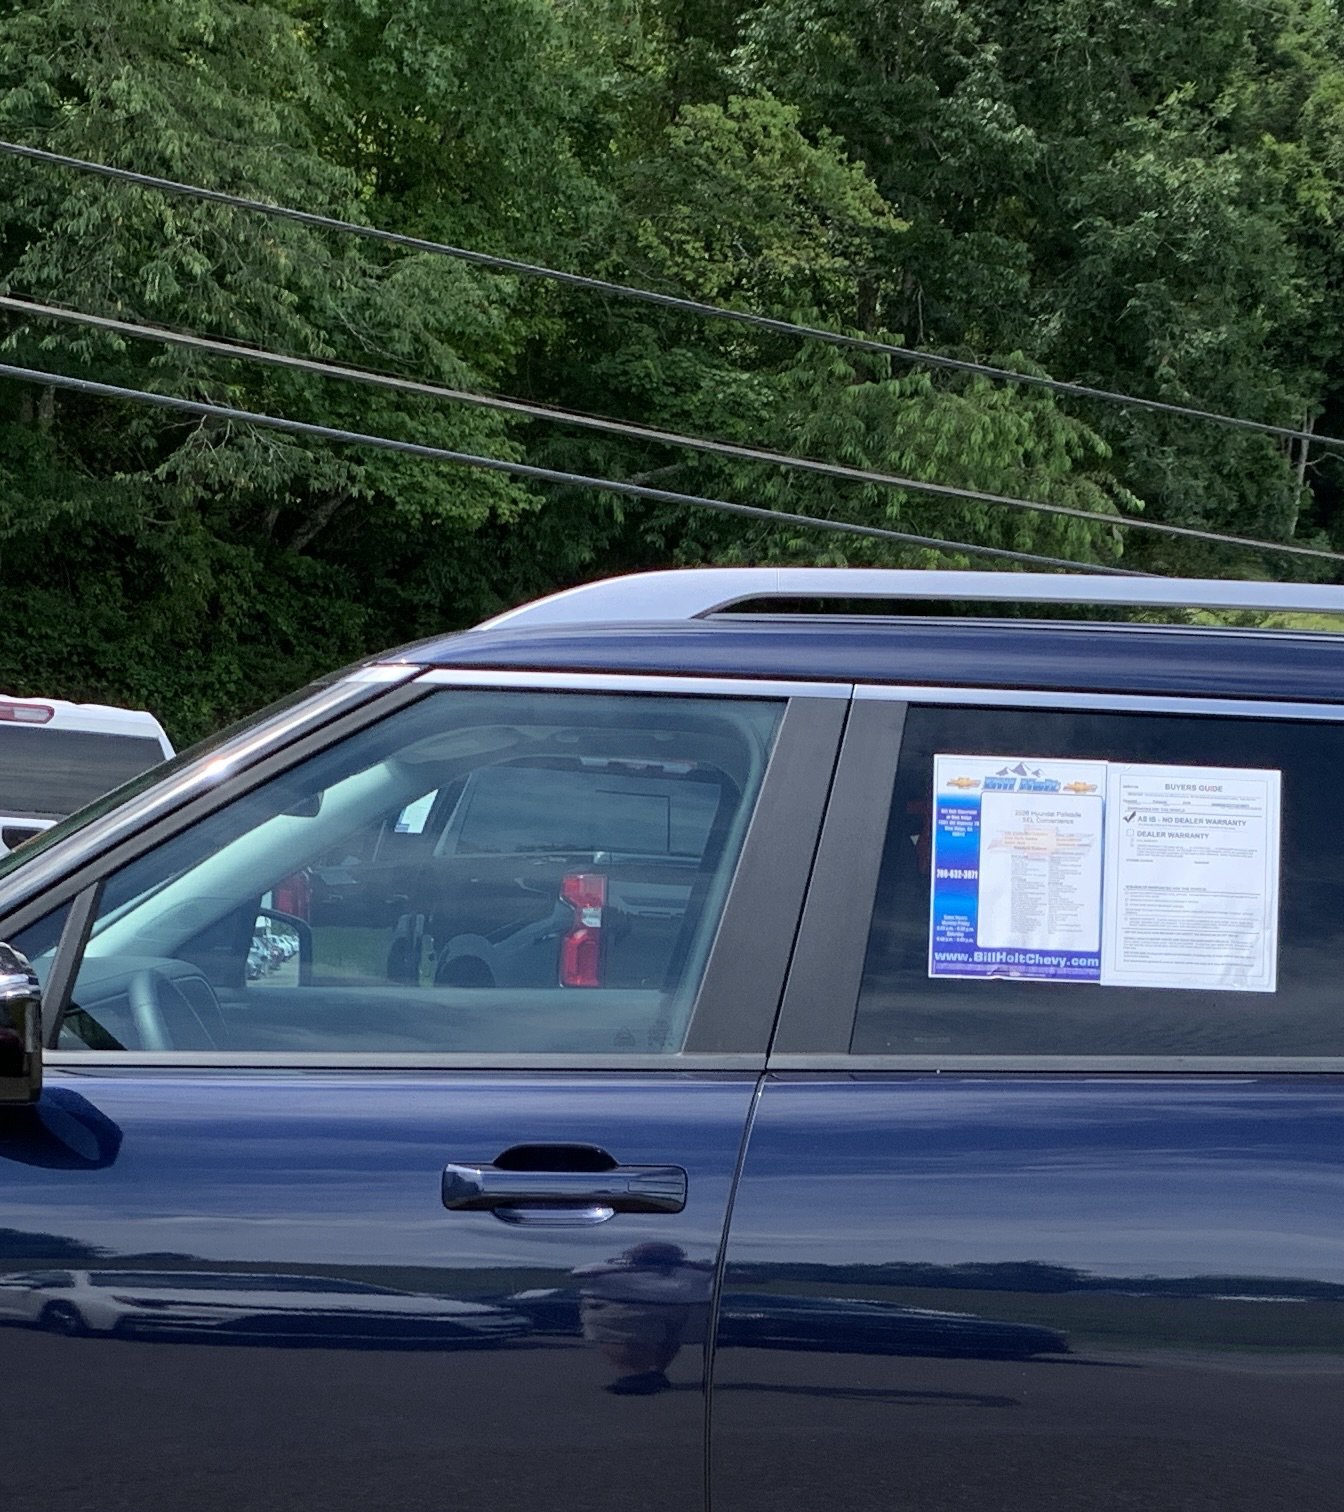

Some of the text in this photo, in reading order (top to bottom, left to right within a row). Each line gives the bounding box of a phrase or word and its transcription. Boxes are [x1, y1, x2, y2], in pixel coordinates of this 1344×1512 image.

[1164, 783, 1223, 793] BUYERS GUIDE
[1162, 816, 1173, 824] NO
[1174, 817, 1204, 825] DEALER
[1205, 818, 1247, 827] WARRANTY
[1136, 830, 1209, 840] DEALER WARRANTY
[934, 951, 1099, 968] www.BillHoltChevy.com
